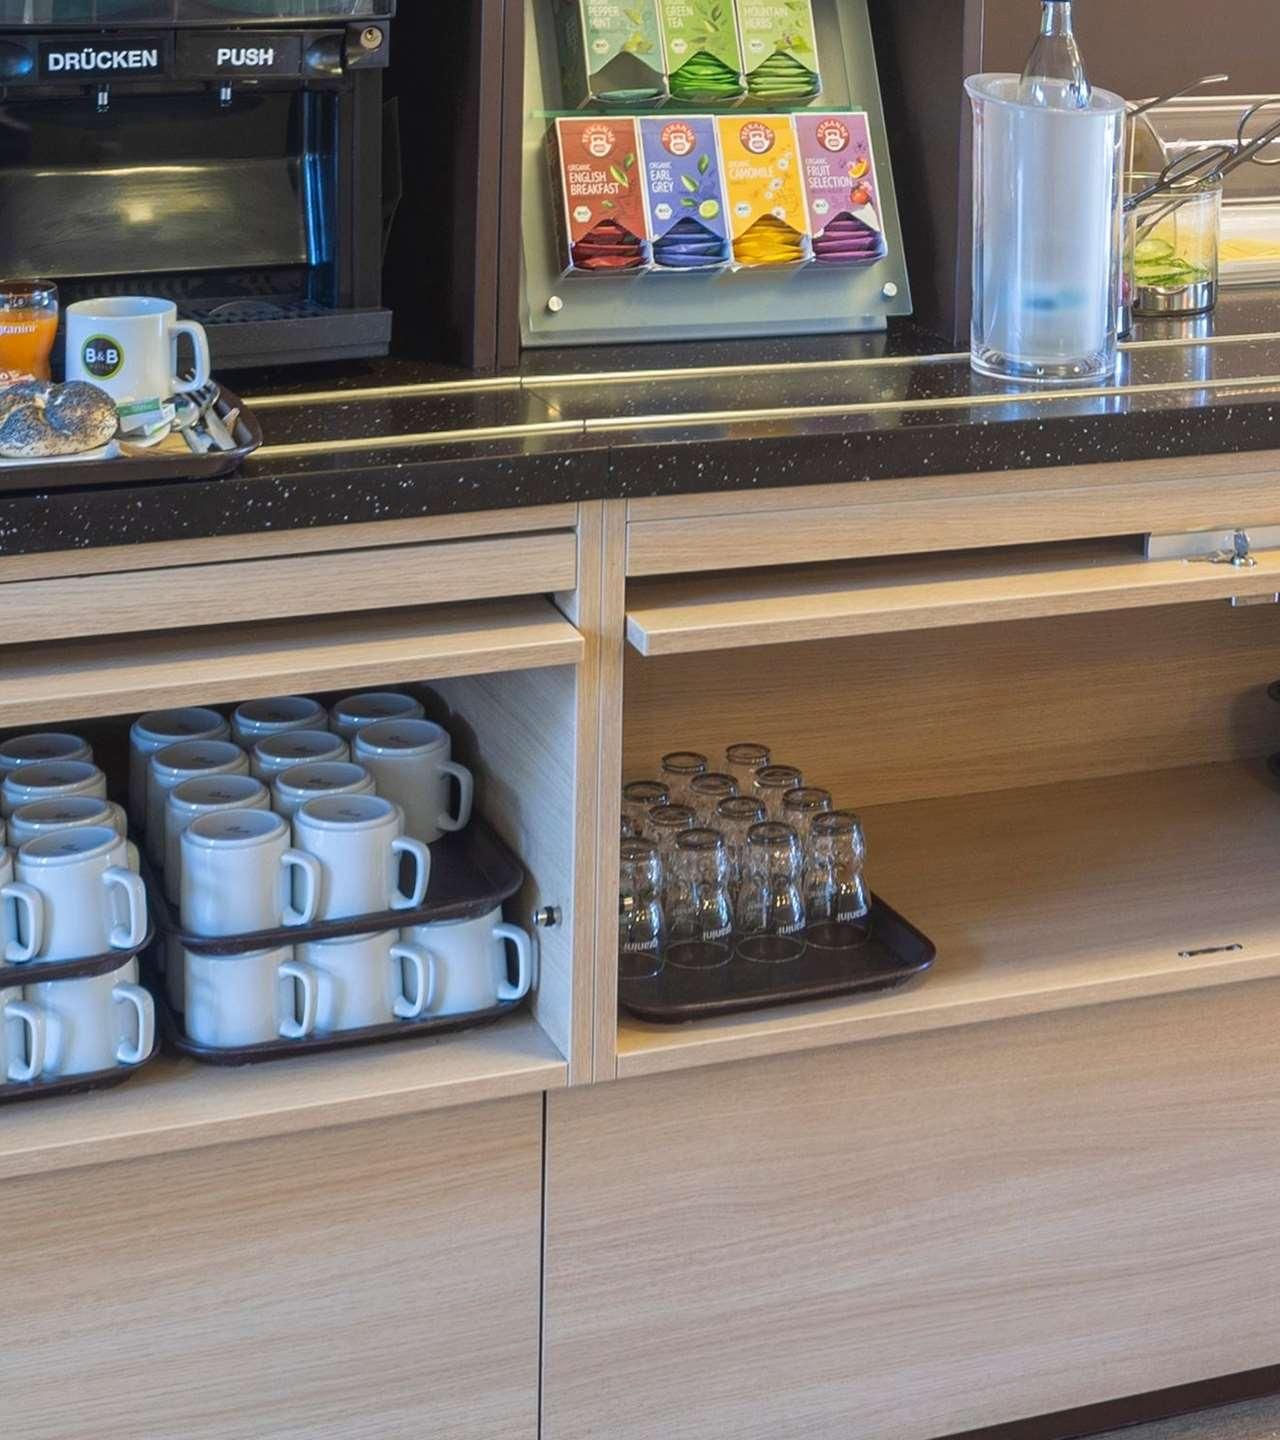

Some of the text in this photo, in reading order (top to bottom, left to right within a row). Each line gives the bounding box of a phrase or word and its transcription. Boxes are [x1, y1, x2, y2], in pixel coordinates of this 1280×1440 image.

[48, 48, 158, 72] DRÜCKEN
[217, 48, 274, 66] PUSH
[569, 170, 607, 183] ENGLISH
[650, 169, 673, 181] EARL
[807, 165, 831, 177] FRUIT
[570, 182, 620, 196] BREAKFAST
[651, 181, 674, 193] GREY
[808, 176, 853, 189] SELECTION
[85, 348, 118, 364] B&B
